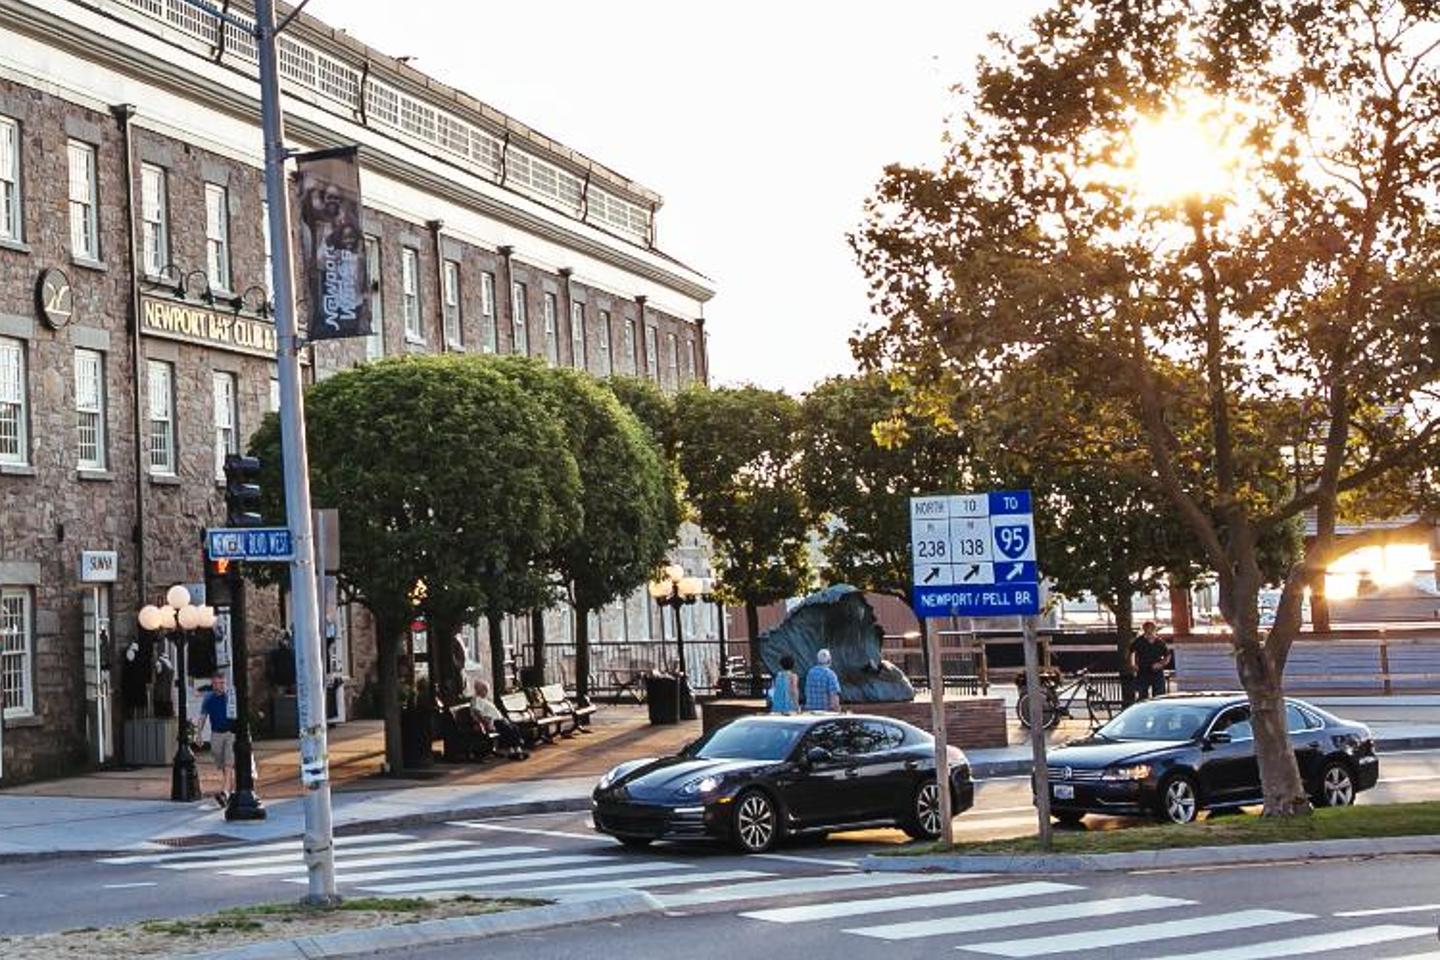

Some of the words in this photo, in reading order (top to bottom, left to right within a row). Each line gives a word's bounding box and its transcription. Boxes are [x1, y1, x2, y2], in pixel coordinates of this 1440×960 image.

[144, 301, 207, 338] NEWPORT
[915, 502, 943, 515] NORTH
[963, 500, 976, 512] TO
[1003, 496, 1019, 510] TO
[1001, 527, 1024, 551] 95
[917, 540, 946, 558] 238
[960, 539, 984, 556] 138
[982, 592, 1010, 606] PELL
